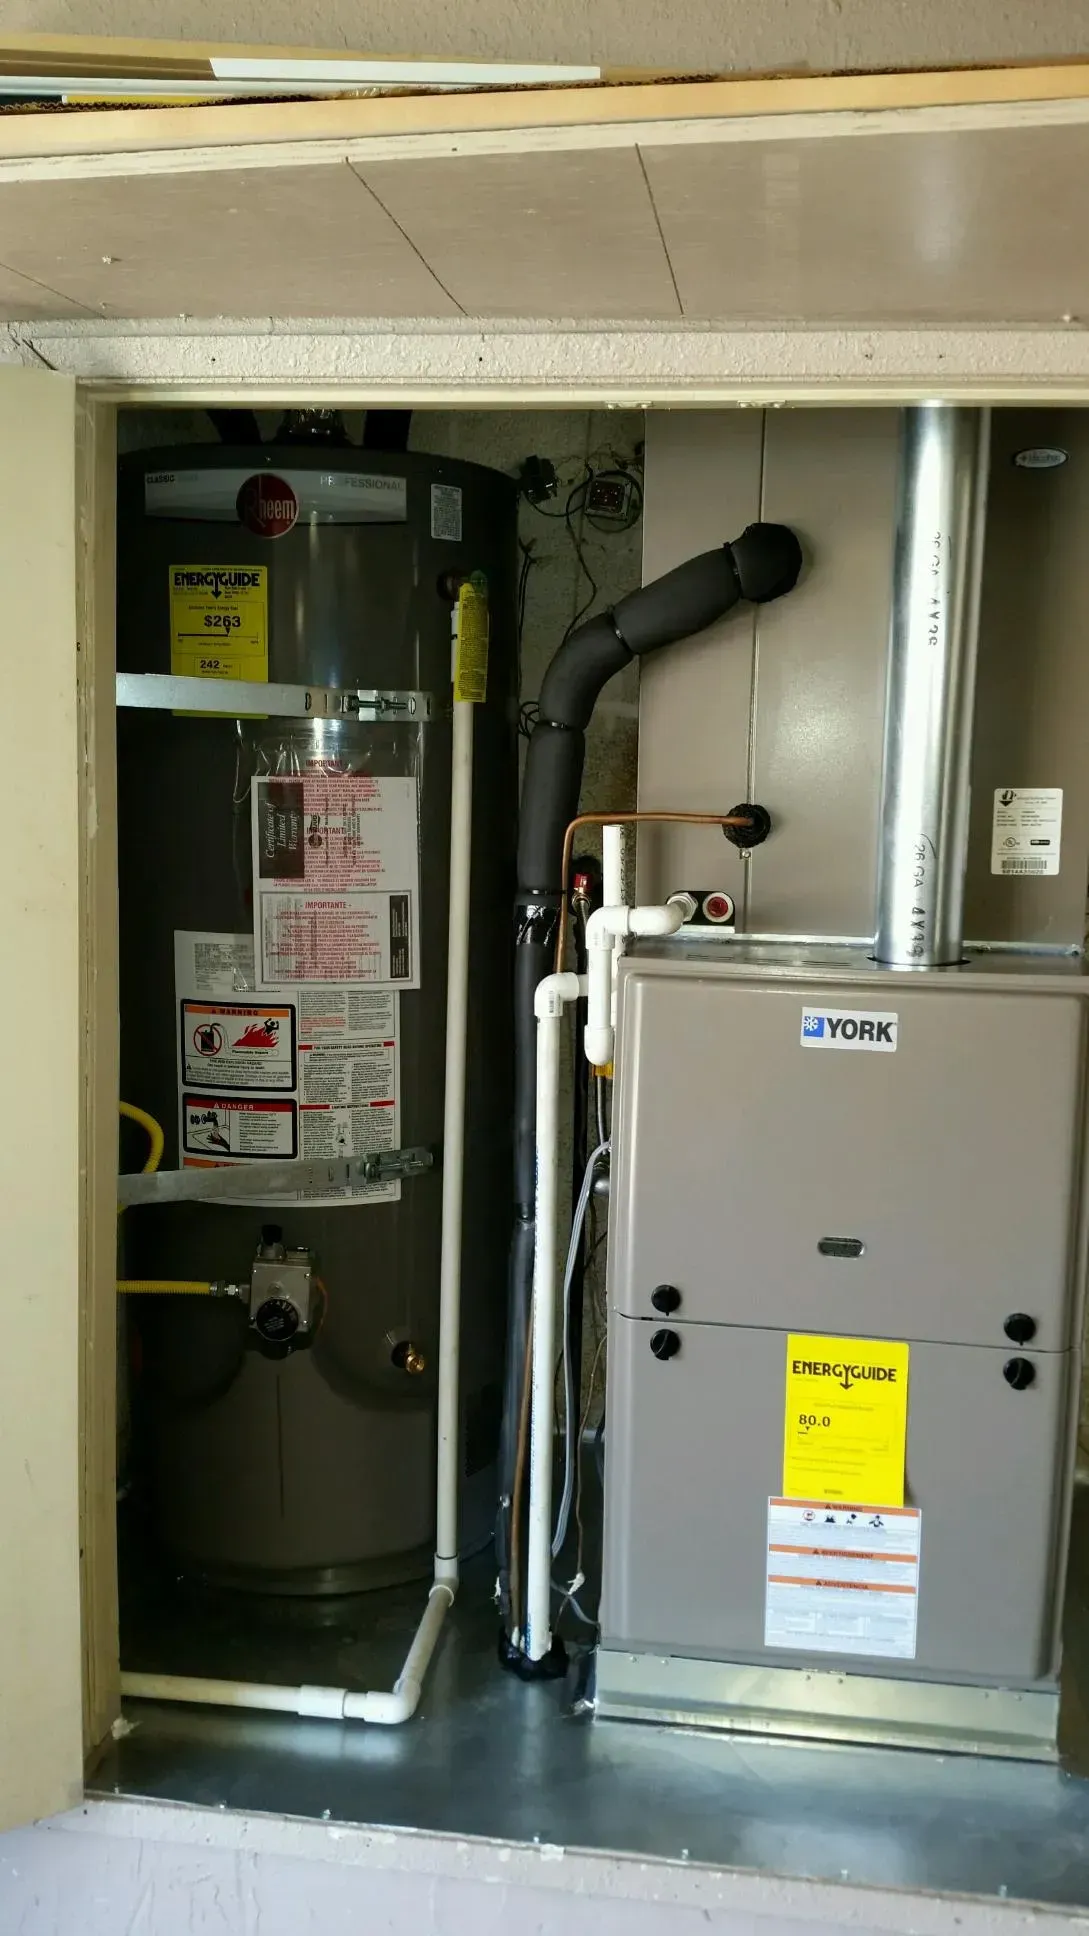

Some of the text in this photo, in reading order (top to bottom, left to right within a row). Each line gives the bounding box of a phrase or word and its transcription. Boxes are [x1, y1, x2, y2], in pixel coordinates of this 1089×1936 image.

[146, 474, 175, 484] CLASSIC
[244, 475, 295, 528] Rheem
[174, 571, 260, 590] ENERGYGUIDE
[204, 615, 241, 627] $263
[200, 660, 219, 669] 242
[265, 814, 276, 858] Certificate
[277, 813, 286, 847] Limited
[287, 811, 299, 850] Warranty
[826, 1017, 893, 1043] YORK
[221, 1103, 254, 1111] DANGER
[792, 1360, 897, 1383] ENERGYGUIDE
[798, 1414, 831, 1427] 80.0
